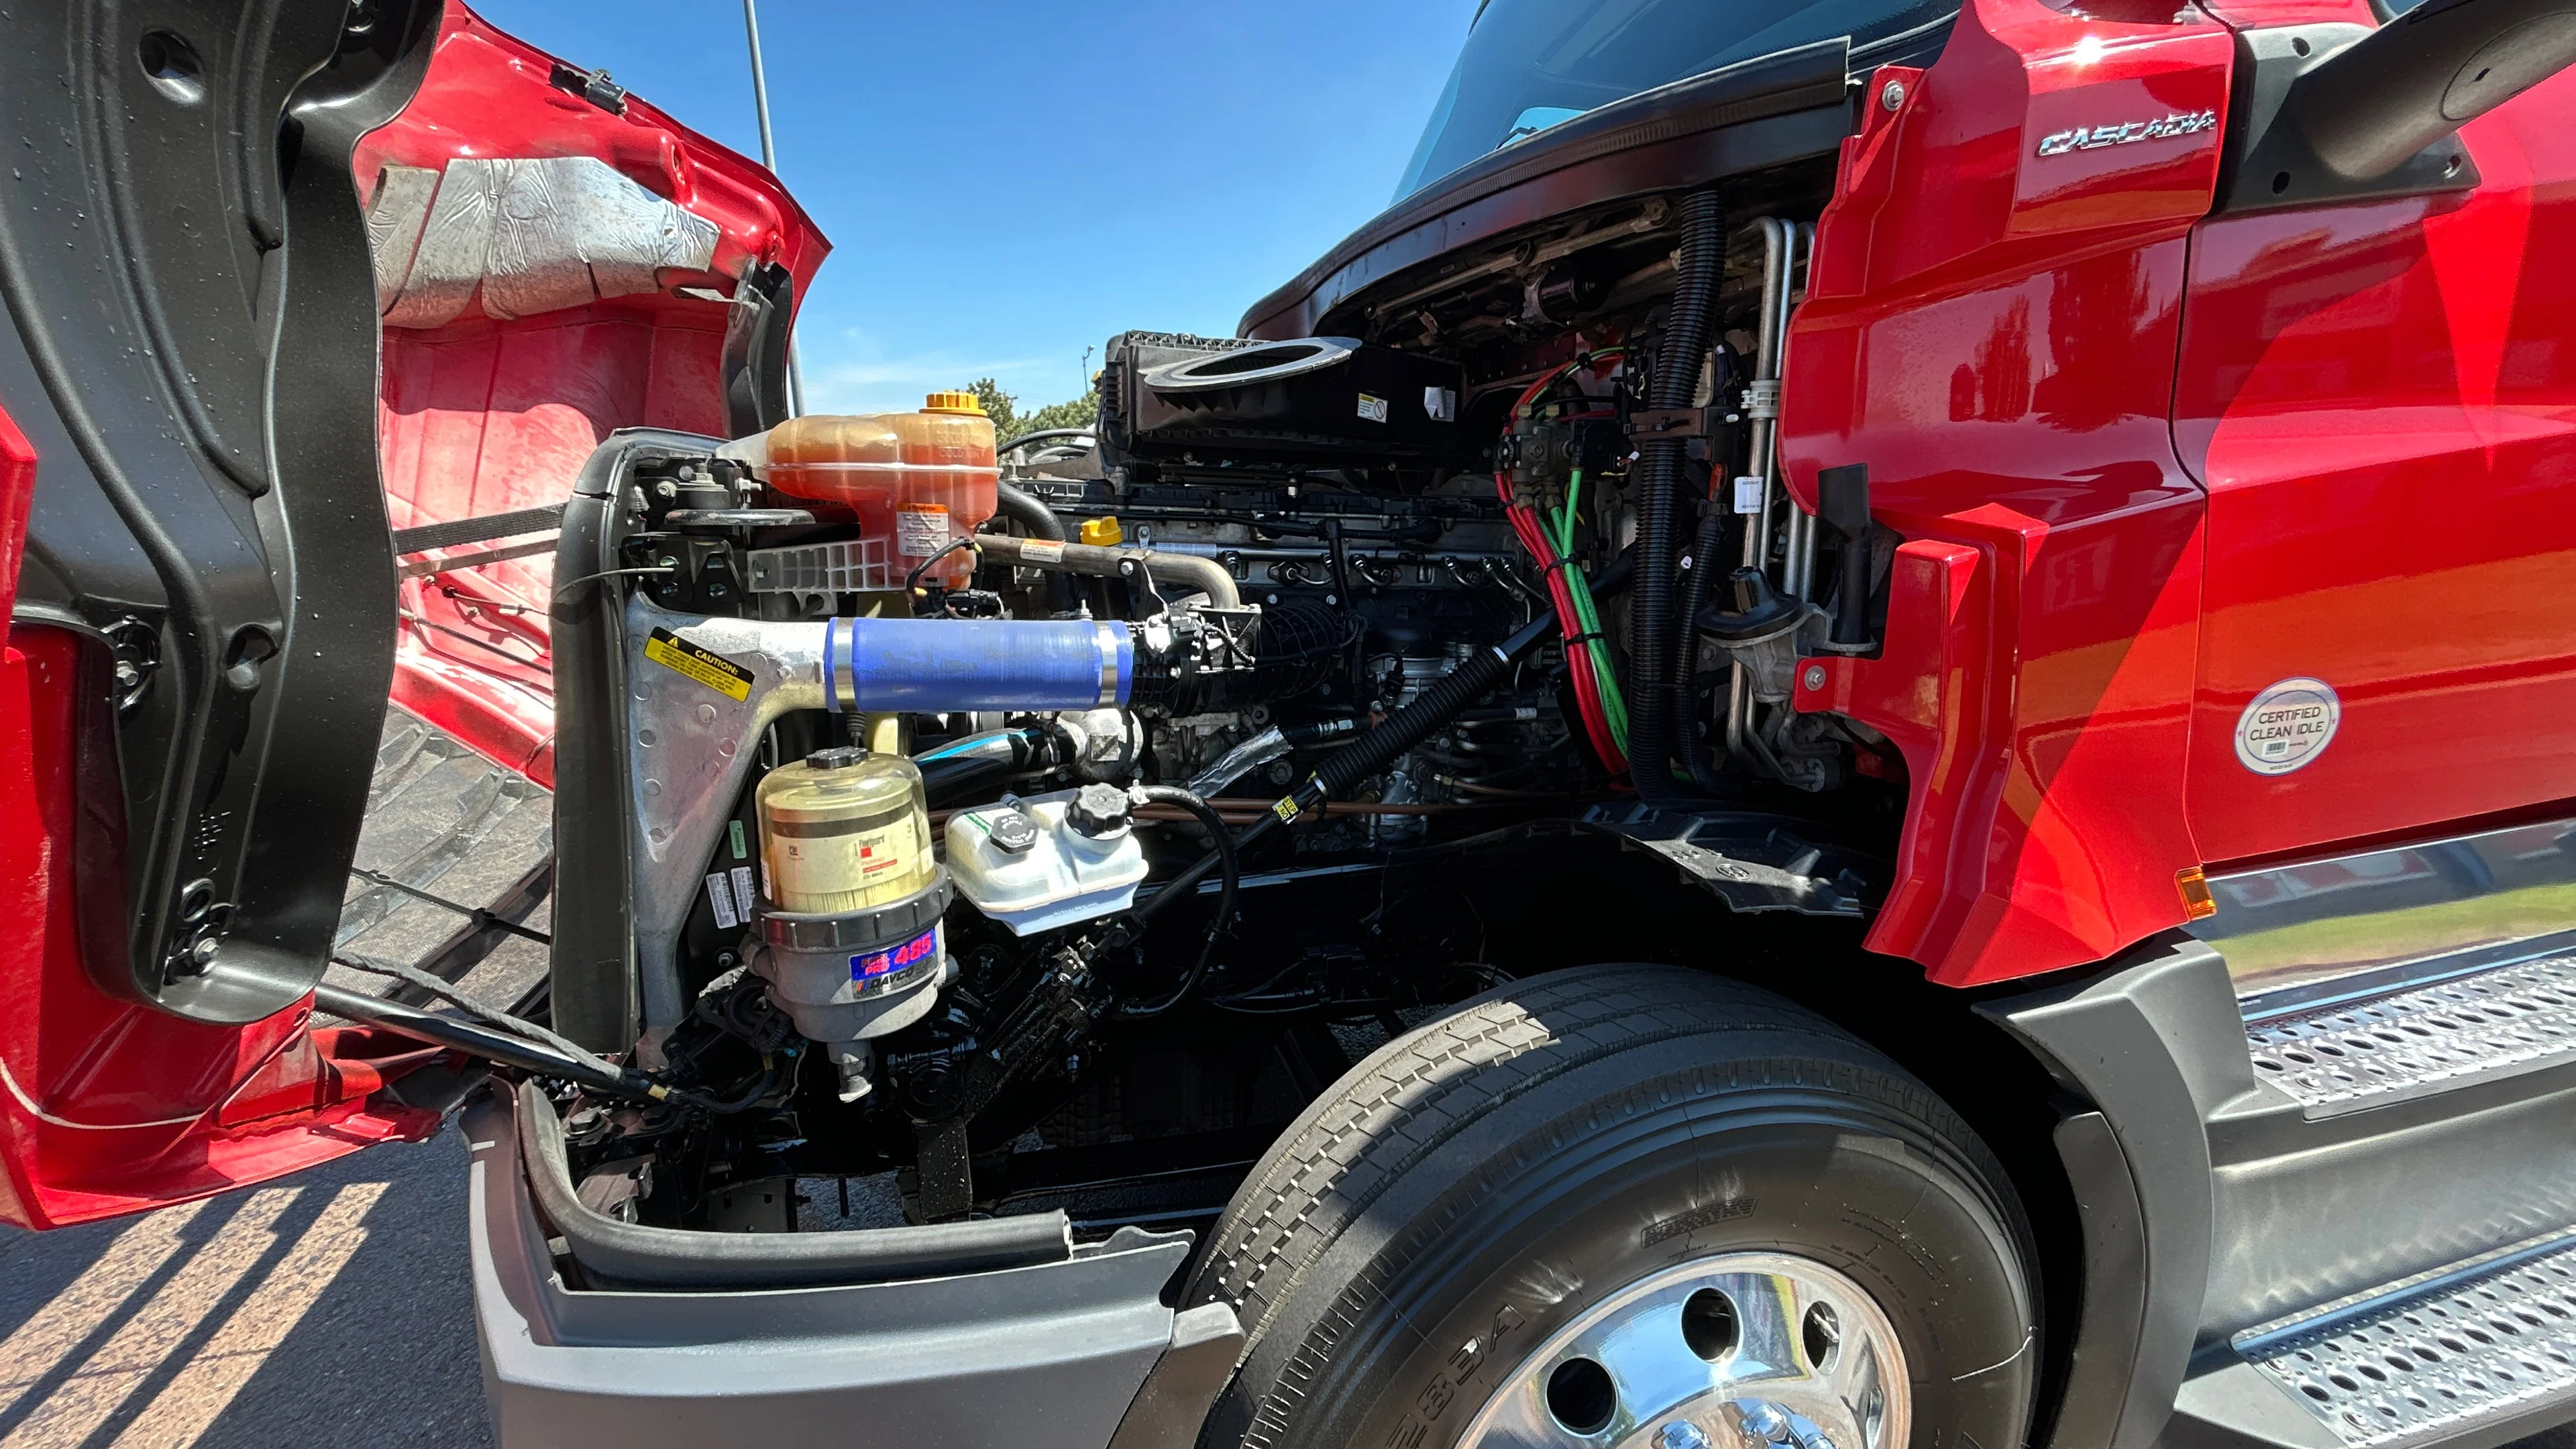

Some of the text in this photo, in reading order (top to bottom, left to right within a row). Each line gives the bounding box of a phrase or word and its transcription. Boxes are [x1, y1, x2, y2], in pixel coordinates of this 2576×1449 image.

[2039, 109, 2216, 156] CASCADIA
[695, 650, 739, 676] CAUTION:
[2259, 706, 2320, 724] CERTIFIED
[2250, 721, 2324, 741] CLEAN IDLE
[894, 932, 932, 964] 485
[865, 961, 890, 976] PRO
[869, 966, 914, 990] DAVCO
